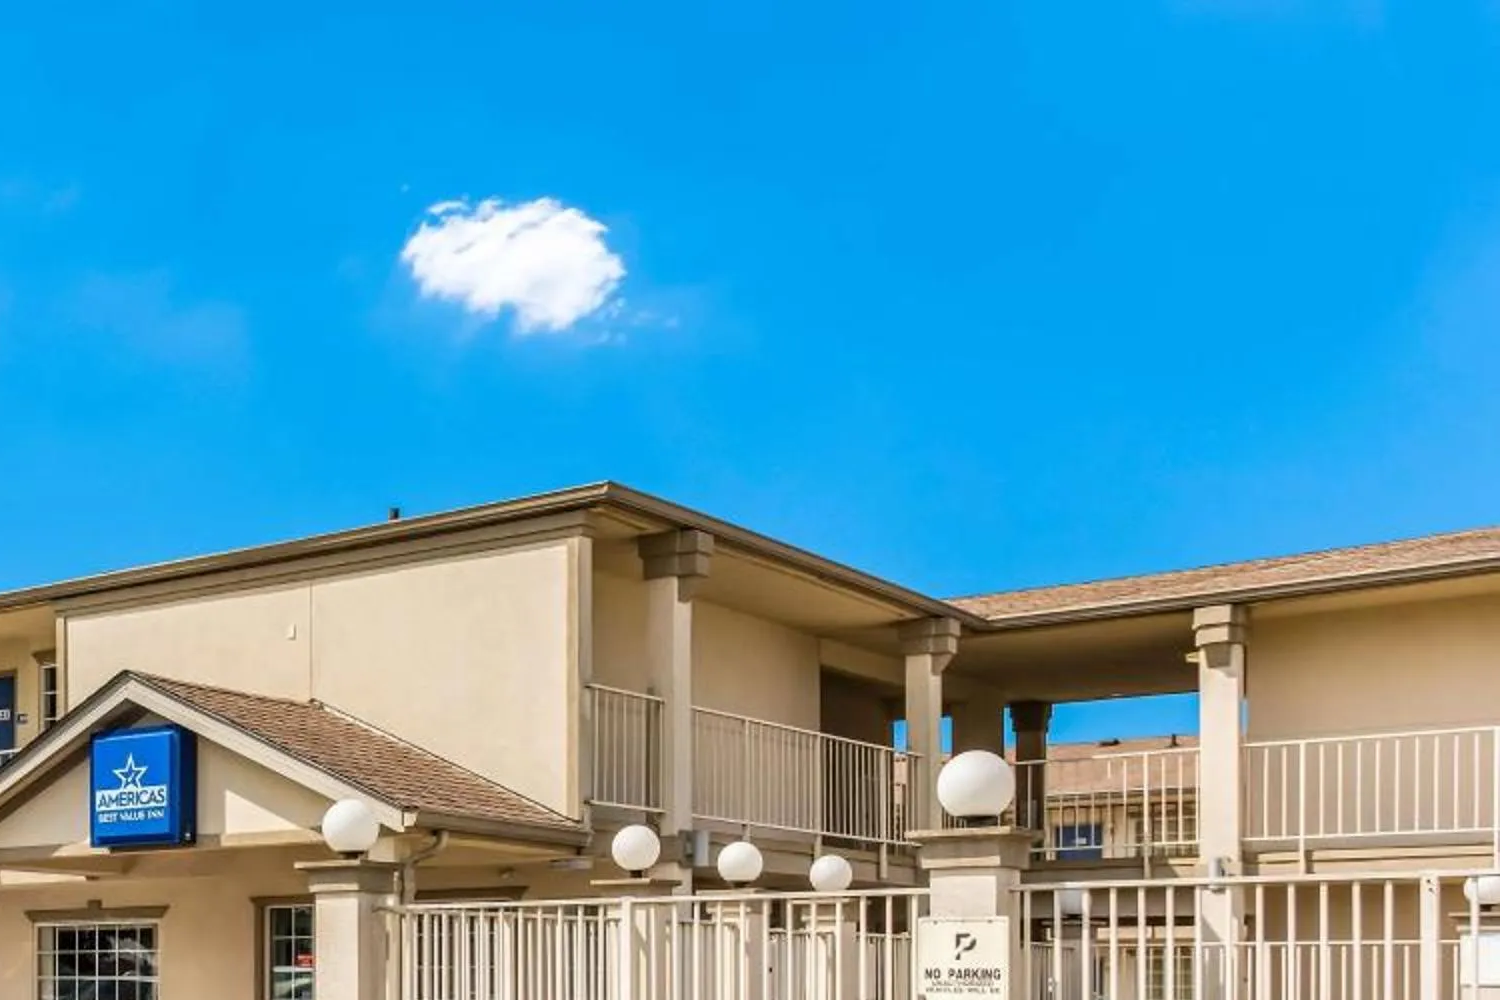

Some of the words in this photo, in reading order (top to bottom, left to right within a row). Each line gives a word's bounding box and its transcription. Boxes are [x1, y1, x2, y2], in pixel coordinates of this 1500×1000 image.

[98, 788, 165, 808] AMERICAS
[925, 967, 941, 979] NO
[948, 967, 1001, 980] PARKING
